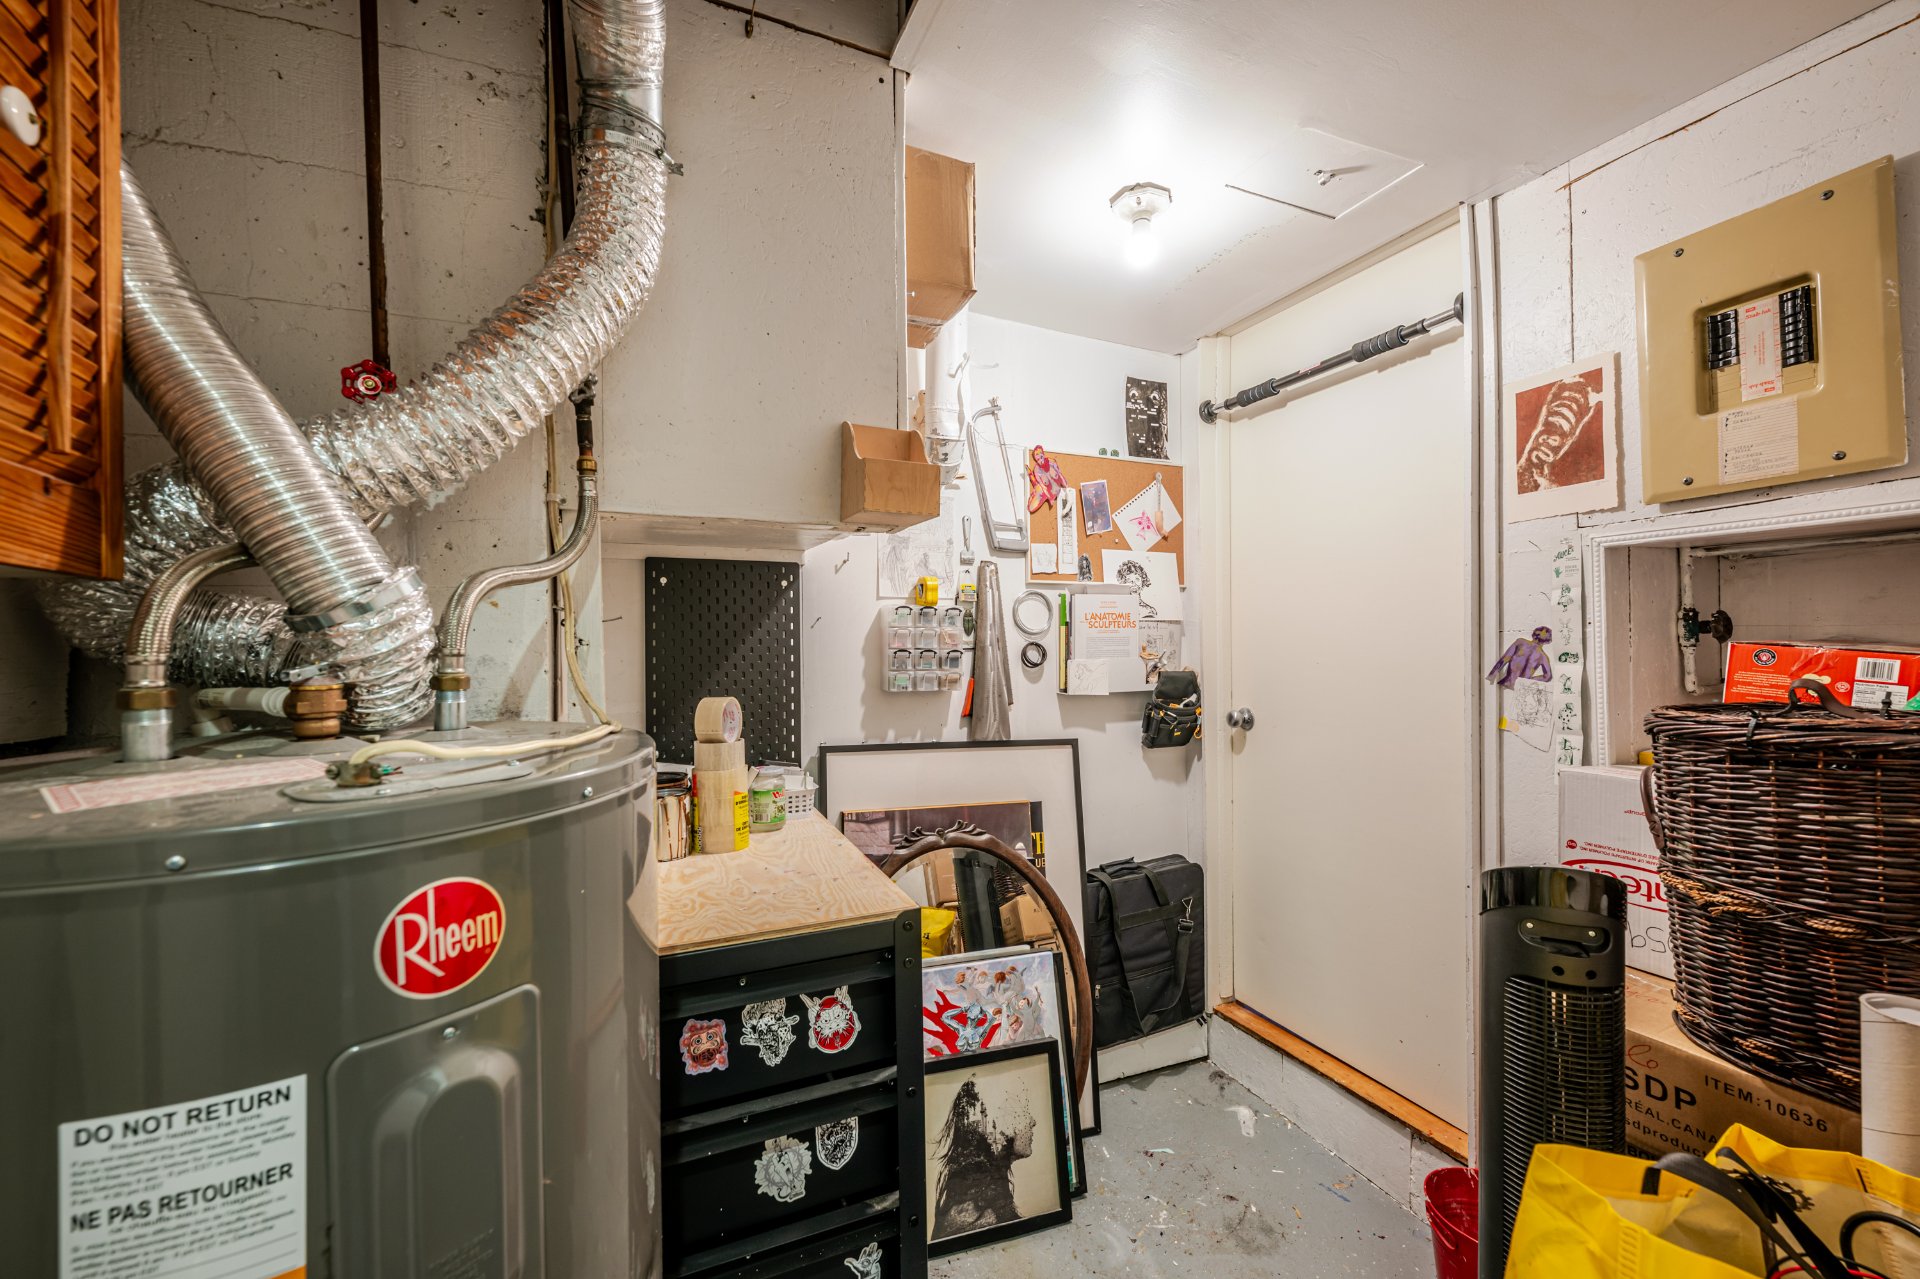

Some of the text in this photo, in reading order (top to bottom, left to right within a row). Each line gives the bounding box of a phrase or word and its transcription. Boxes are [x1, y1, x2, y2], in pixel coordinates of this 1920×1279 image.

[1084, 612, 1131, 621] L'ANATOMIE
[1088, 620, 1137, 629] SCULPTEURS
[394, 887, 499, 987] Rheem
[74, 1085, 292, 1147] DO NOT RETURN
[1625, 1097, 1717, 1144] RÉAL.CANA
[1704, 1074, 1829, 1133] ITEM:10636
[70, 1163, 292, 1233] NE PAS RETOURNER
